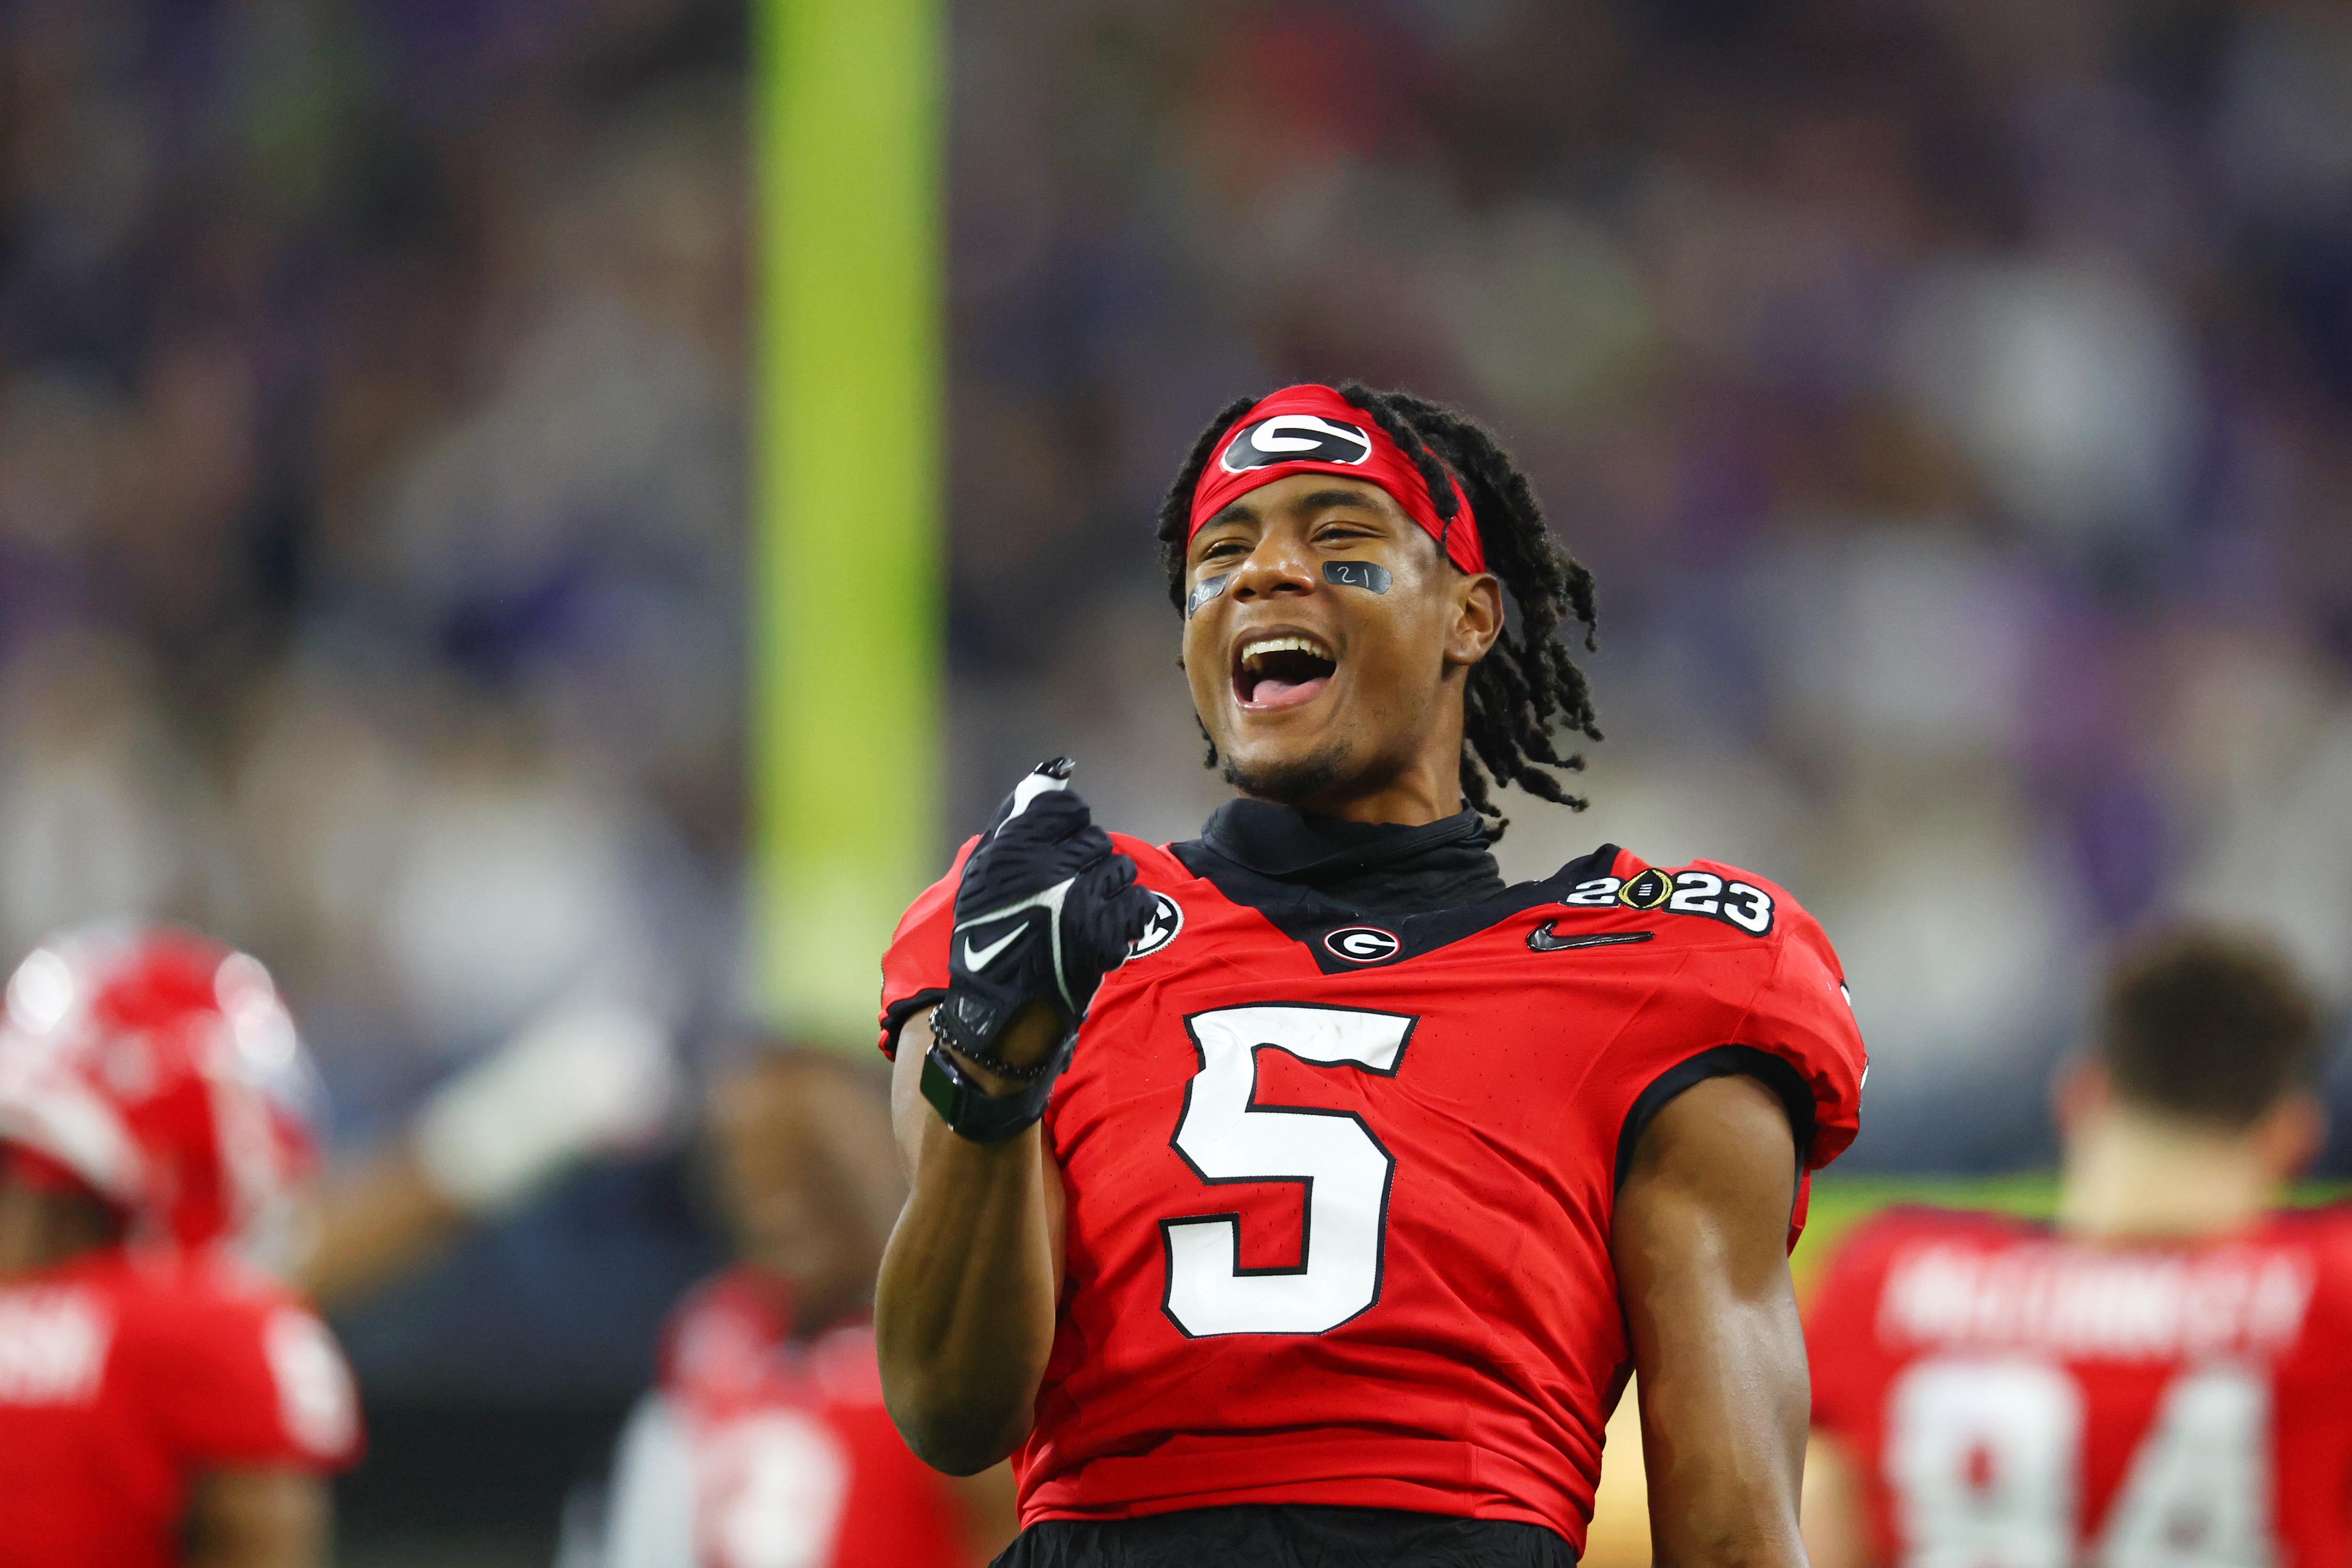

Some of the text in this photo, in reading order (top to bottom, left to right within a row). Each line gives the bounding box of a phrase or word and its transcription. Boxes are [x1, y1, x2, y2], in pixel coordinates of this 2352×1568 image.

[1337, 566, 1369, 587] 21
[1565, 868, 1773, 934] 2023
[1159, 1001, 1420, 1340] 5
